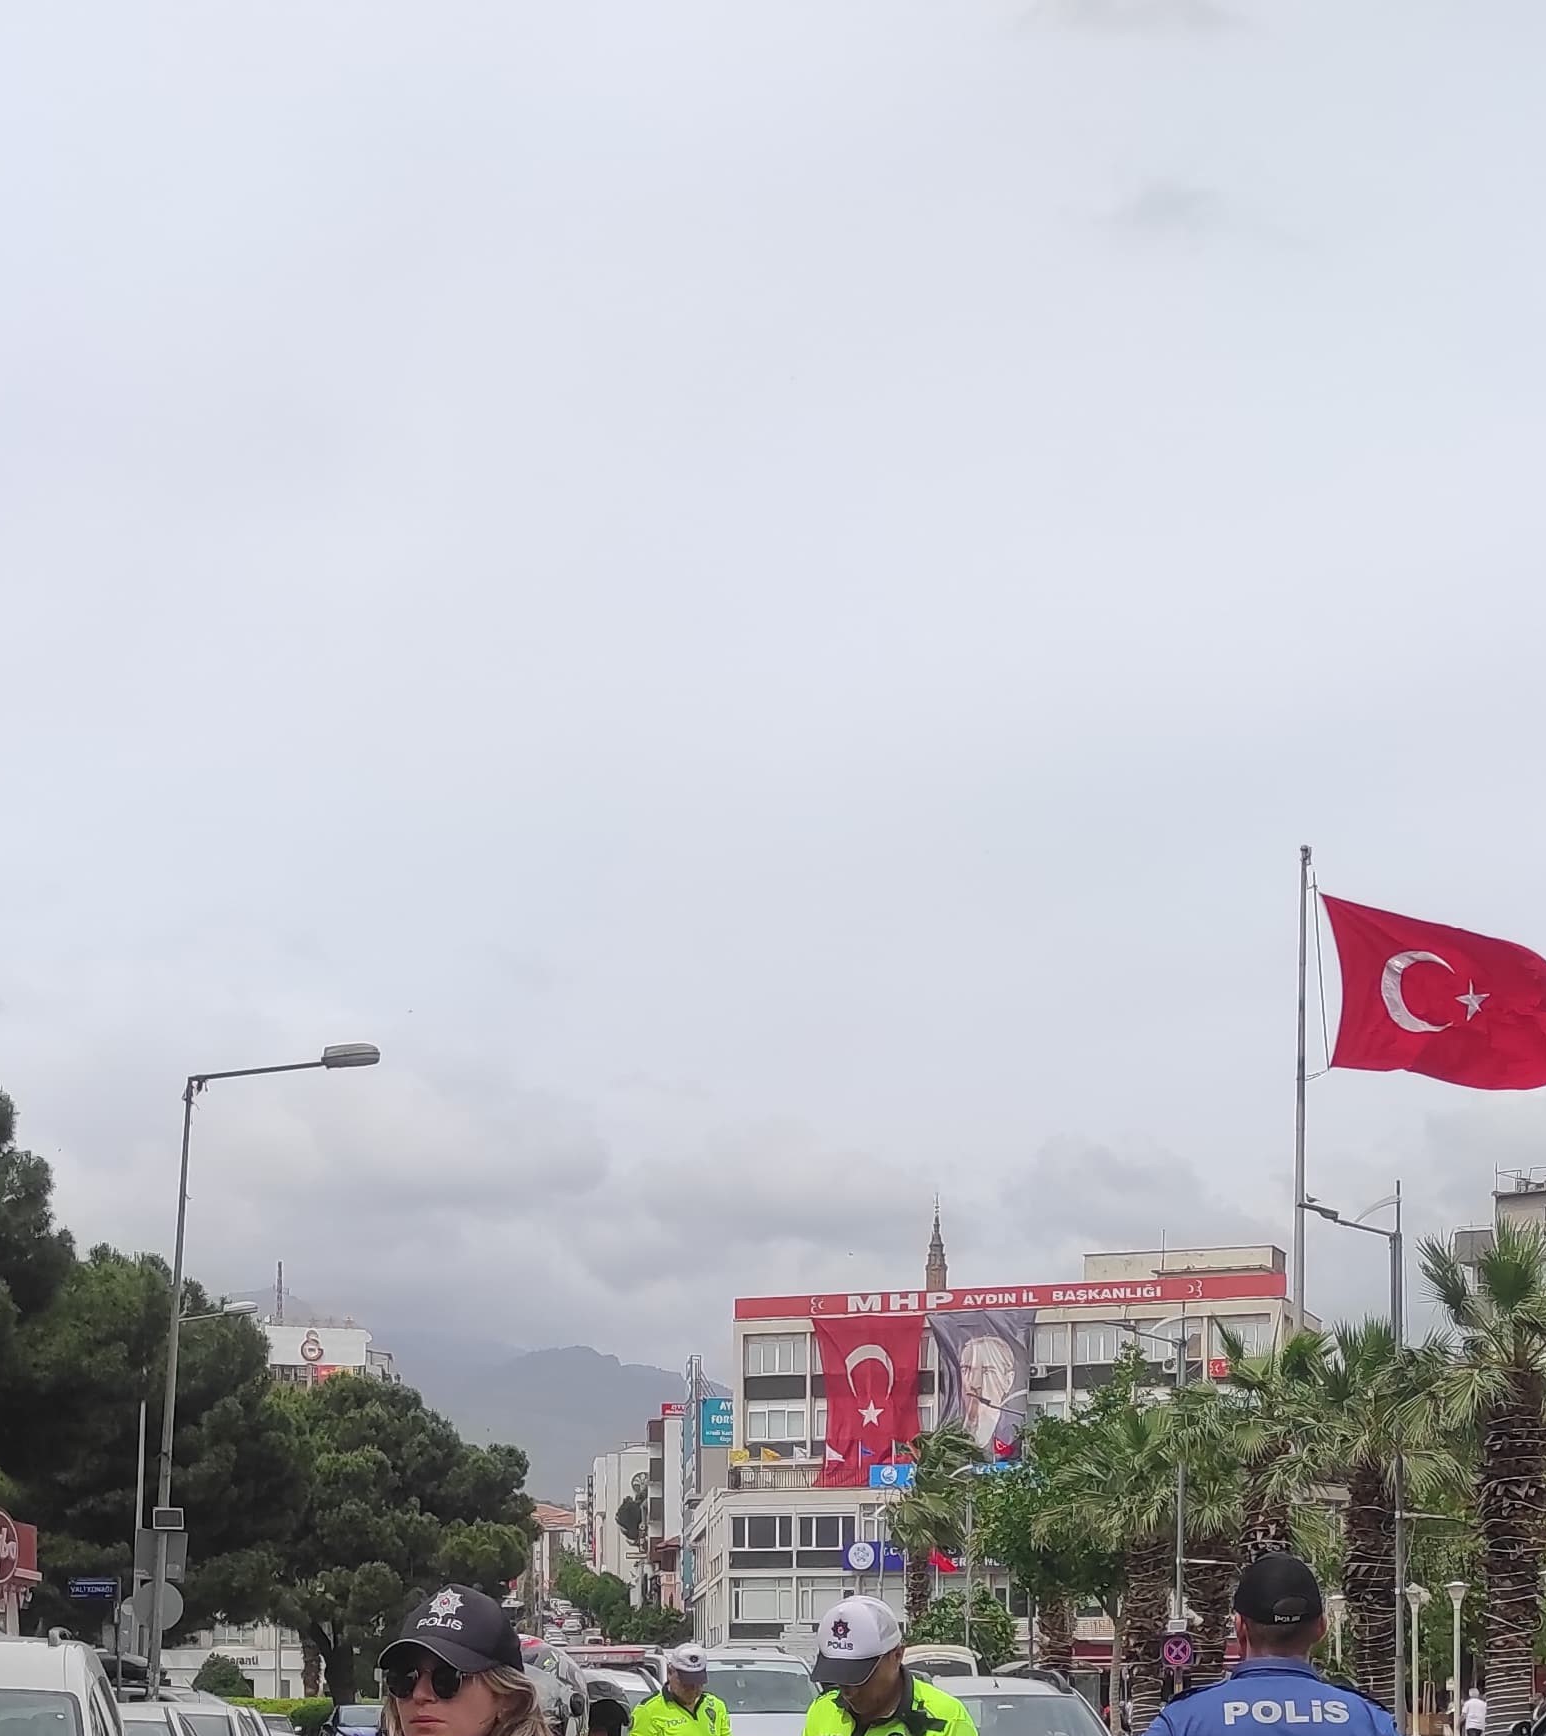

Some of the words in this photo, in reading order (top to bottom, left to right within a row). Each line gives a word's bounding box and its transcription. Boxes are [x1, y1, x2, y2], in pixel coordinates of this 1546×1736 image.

[847, 1291, 954, 1312] MHP
[962, 1293, 1016, 1306] AYDIN
[1021, 1288, 1039, 1303] İL
[1052, 1285, 1163, 1304] BAŞKANLIĞI
